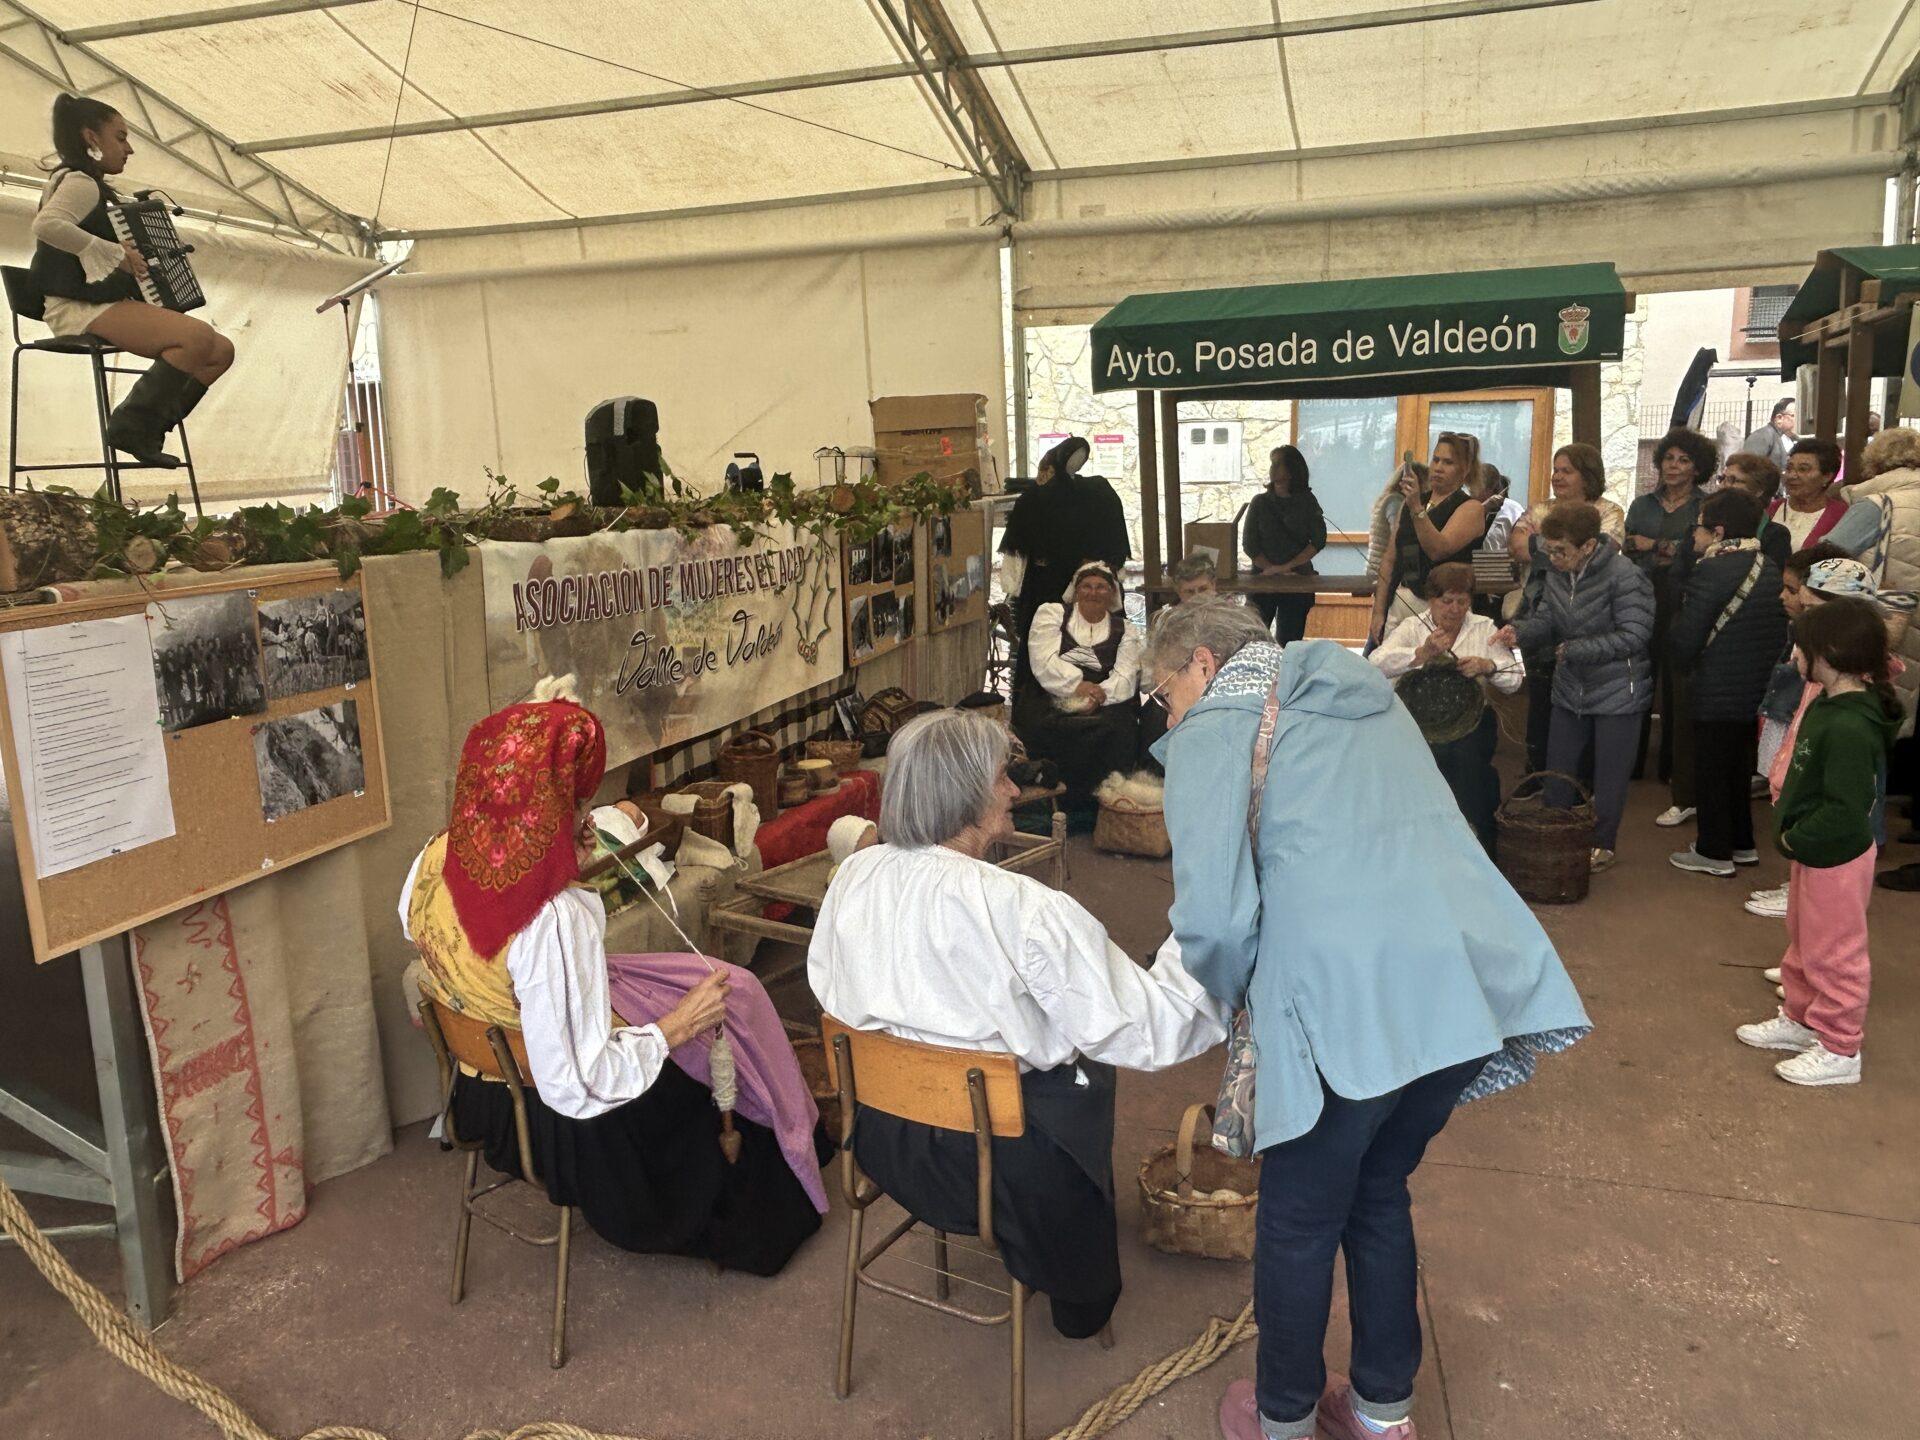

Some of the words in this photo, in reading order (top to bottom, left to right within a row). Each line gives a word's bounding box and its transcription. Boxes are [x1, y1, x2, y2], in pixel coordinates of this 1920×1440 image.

[1106, 344, 1182, 381] Ayto.
[1195, 332, 1317, 373] Posada
[1332, 330, 1375, 363] de
[1388, 315, 1537, 358] Valdeón
[513, 562, 645, 633] ASOCIACIÓN
[649, 563, 673, 608] DE
[679, 553, 755, 604] MUJERES
[754, 554, 777, 589] EL
[616, 629, 684, 696] Valle
[692, 638, 717, 678] de
